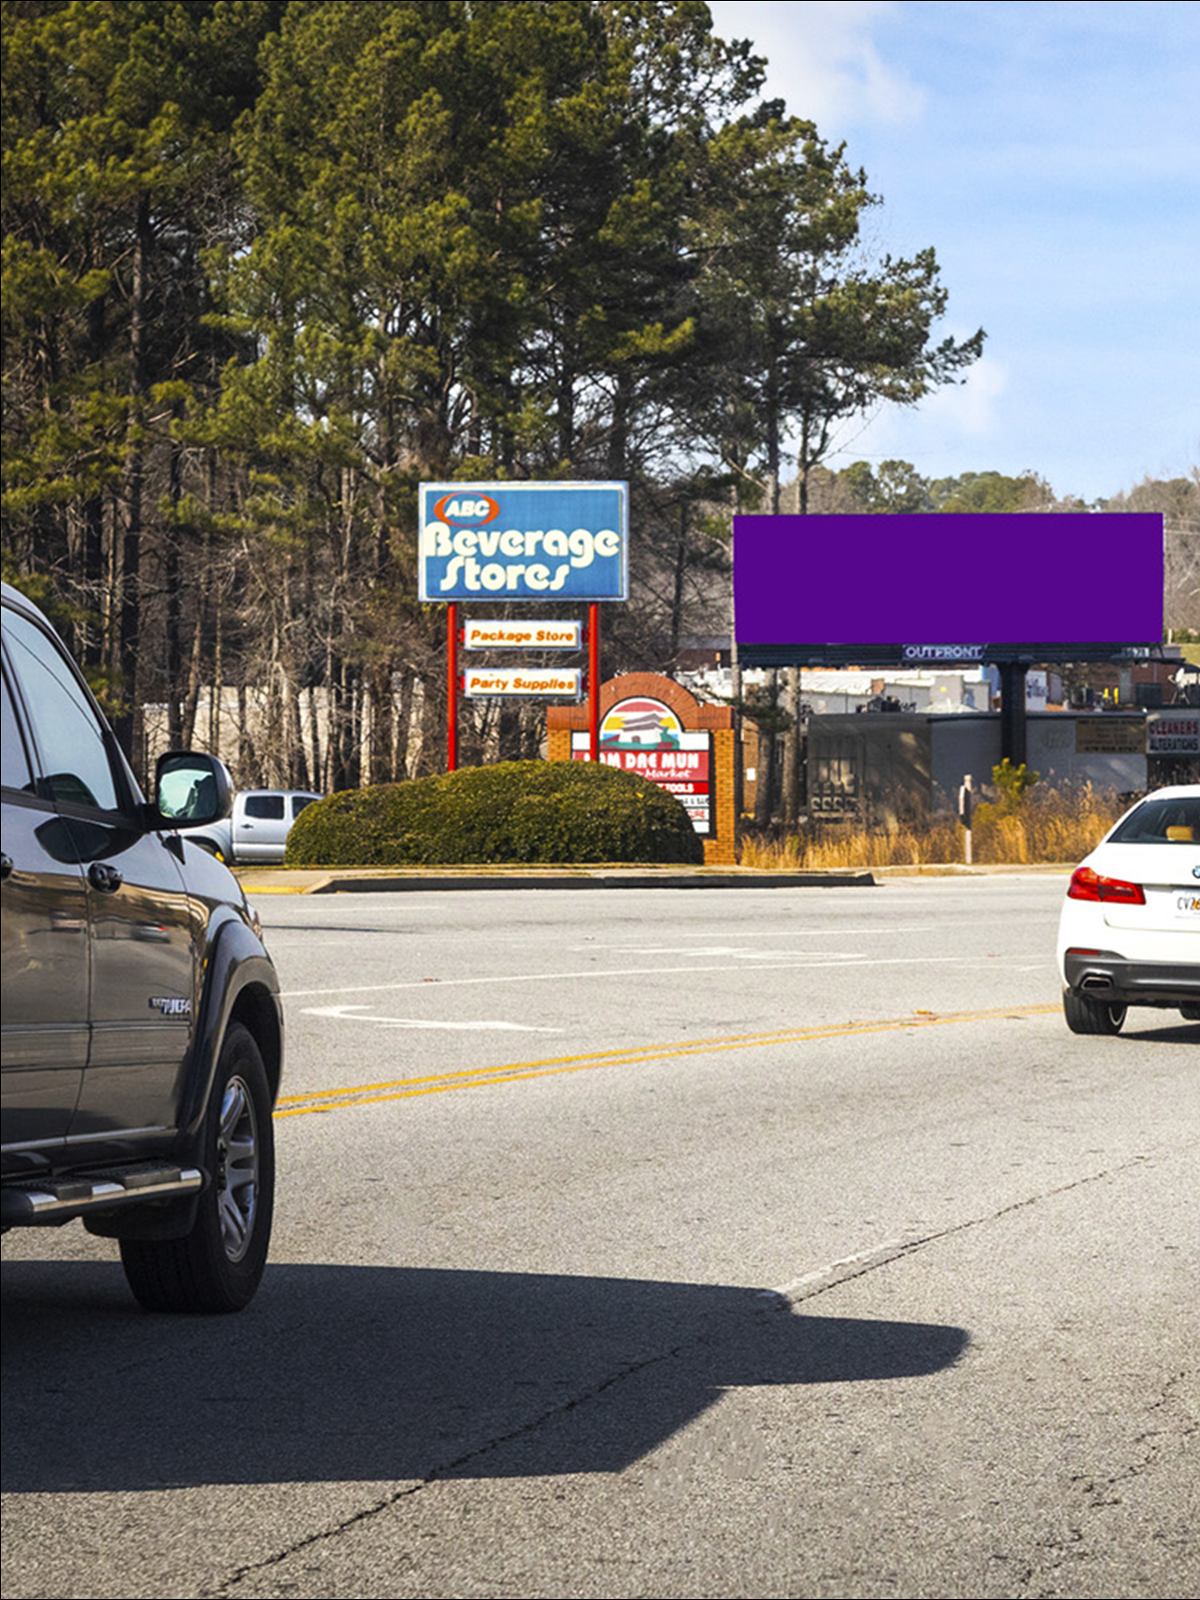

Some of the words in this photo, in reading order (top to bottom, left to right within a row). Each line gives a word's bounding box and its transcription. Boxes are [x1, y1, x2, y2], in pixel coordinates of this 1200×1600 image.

[444, 501, 490, 517] ABC
[424, 521, 620, 568] Beverage
[440, 556, 570, 591] Stores
[471, 630, 532, 643] Package
[536, 630, 574, 641] Store
[905, 646, 981, 658] OUTFRONT
[470, 678, 509, 691] Party
[513, 678, 574, 691] Supplies
[1149, 720, 1199, 735] CLEANERS
[626, 753, 657, 768] DAE
[661, 753, 699, 768] MUN
[645, 769, 692, 778] Market
